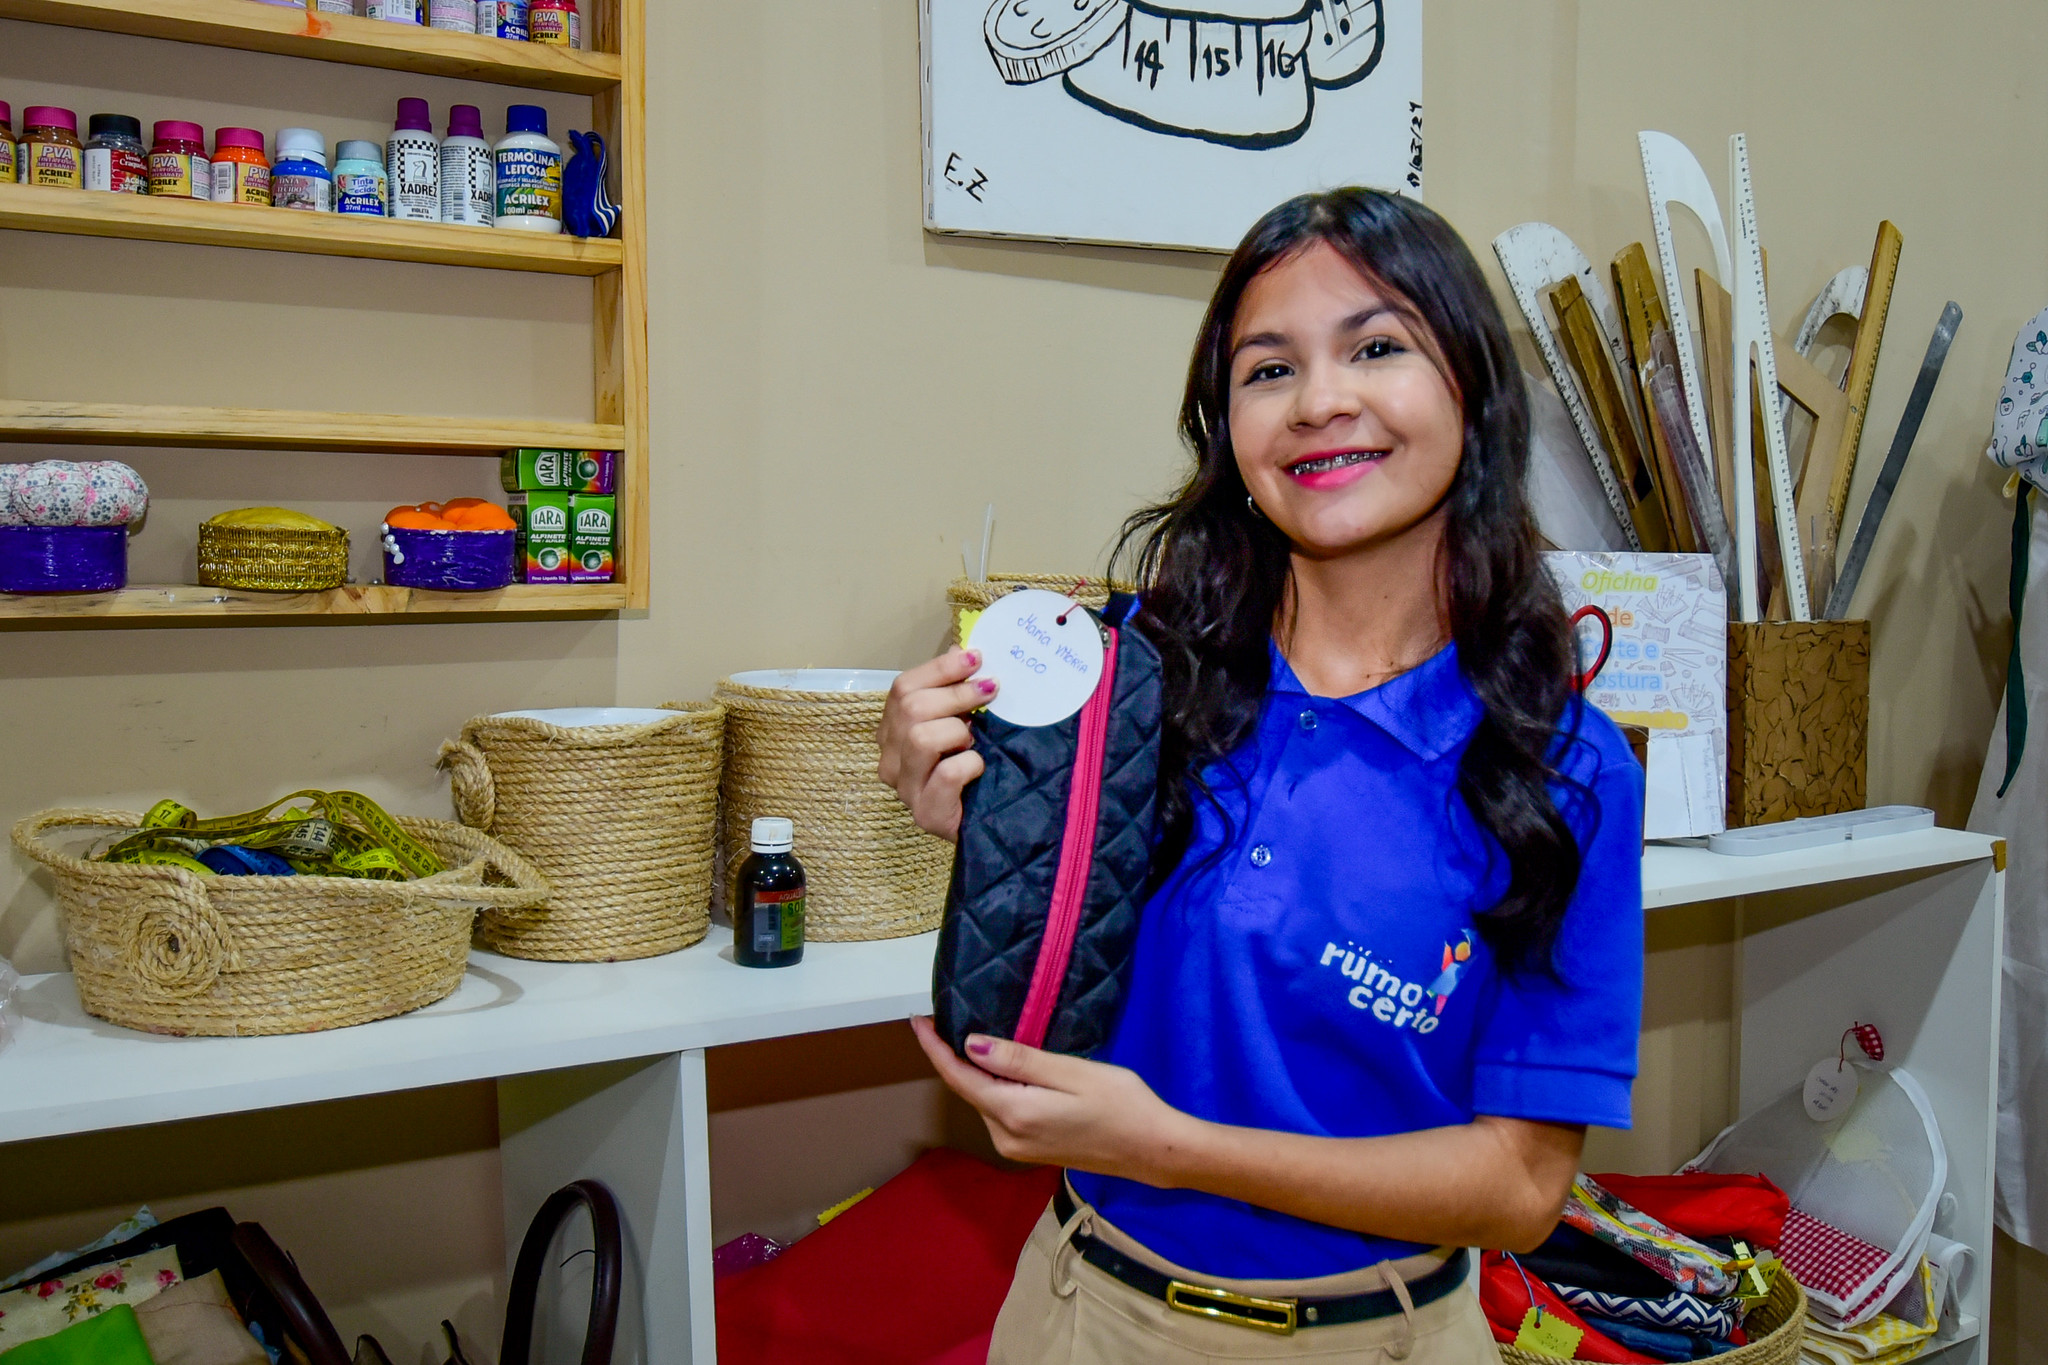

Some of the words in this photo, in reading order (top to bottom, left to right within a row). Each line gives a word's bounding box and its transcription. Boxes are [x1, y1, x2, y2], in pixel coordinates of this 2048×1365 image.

[535, 12, 558, 22] PVA
[1134, 40, 1163, 90] 14
[1203, 40, 1231, 79] 15
[1264, 41, 1297, 78] 16
[42, 146, 72, 159] PVA
[498, 151, 555, 167] TERMOLINA
[153, 156, 177, 168] PVA
[38, 169, 72, 178] ACRILEX
[505, 164, 547, 177] LEITOSA
[400, 183, 437, 197] XADREZ
[344, 197, 379, 207] ACRILEX
[504, 194, 549, 207] ACRILEX
[504, 206, 525, 215] 100ml
[539, 455, 554, 483] IARA
[535, 510, 562, 525] IARA
[580, 513, 607, 528] IARA
[1581, 570, 1658, 594] Oficina
[1608, 606, 1634, 627] de
[1017, 613, 1051, 646] Maria
[1582, 638, 1640, 658] Cote
[1644, 642, 1660, 658] e
[1594, 673, 1662, 692] ostura
[159, 809, 171, 820] 17
[296, 821, 310, 839] 145
[312, 824, 328, 843] 144
[390, 833, 400, 846] 54
[400, 842, 411, 855] 55
[411, 850, 422, 863] 56
[421, 858, 432, 872] 57
[1348, 986, 1439, 1034] certo
